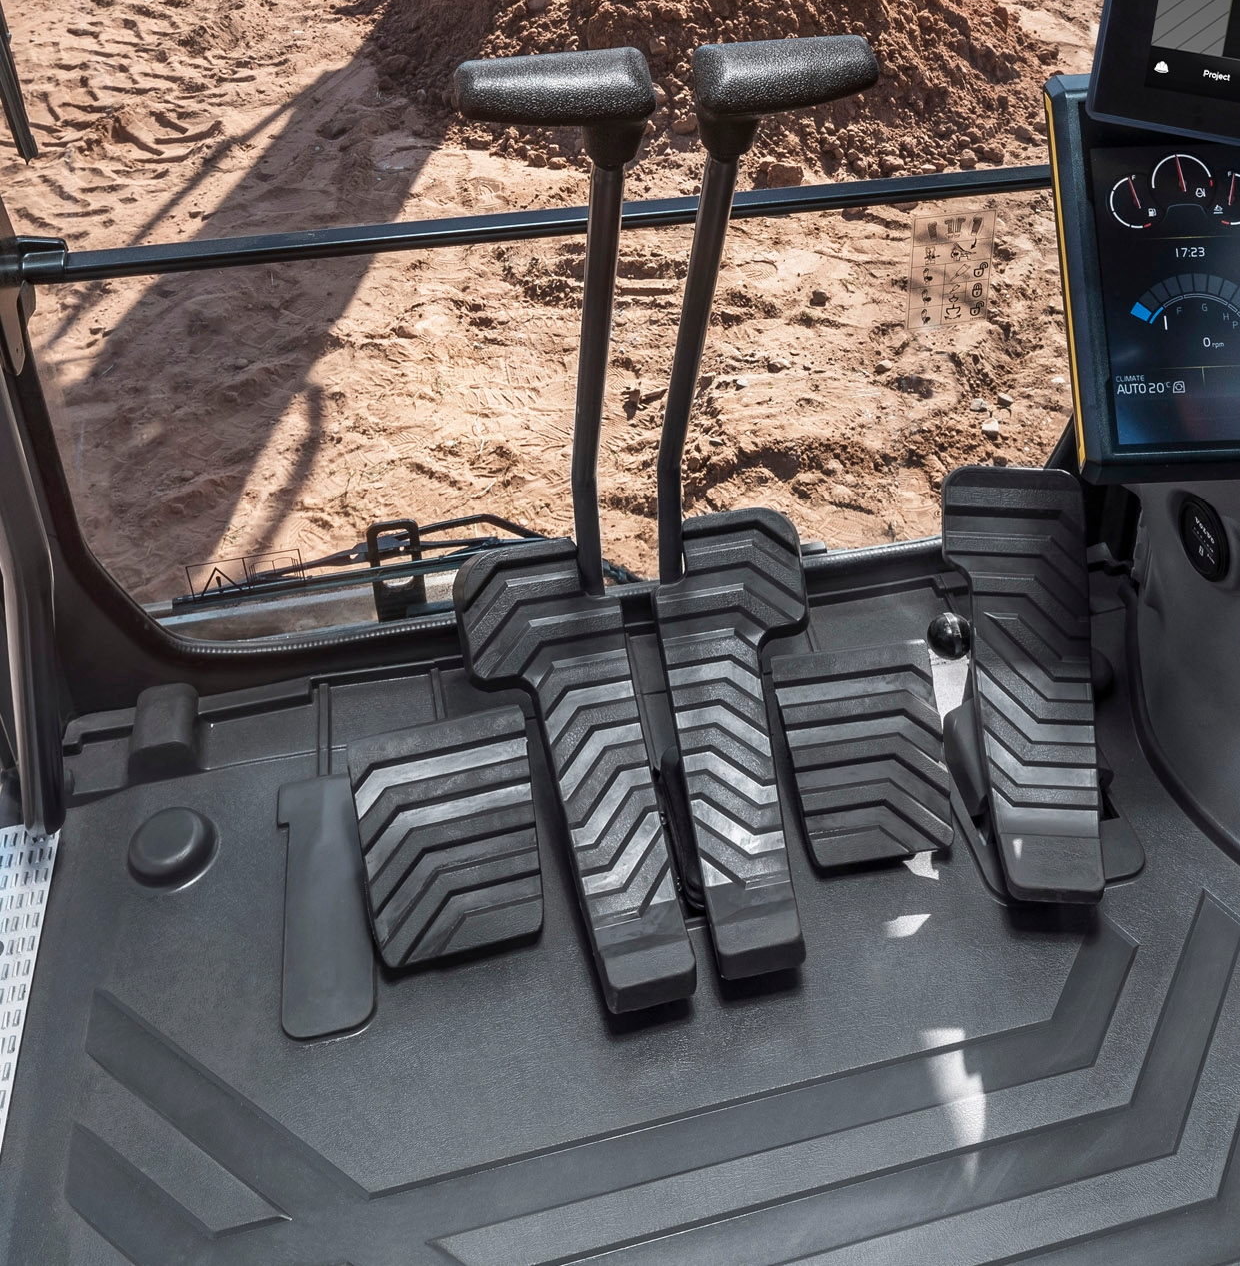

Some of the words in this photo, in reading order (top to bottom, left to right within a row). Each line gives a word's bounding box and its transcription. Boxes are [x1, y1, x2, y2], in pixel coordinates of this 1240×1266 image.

[1203, 69, 1231, 82] Project
[1175, 247, 1206, 258] 17:23
[1203, 337, 1211, 347] 0
[1117, 383, 1147, 394] AUTO
[1195, 516, 1214, 544] VOLVO
